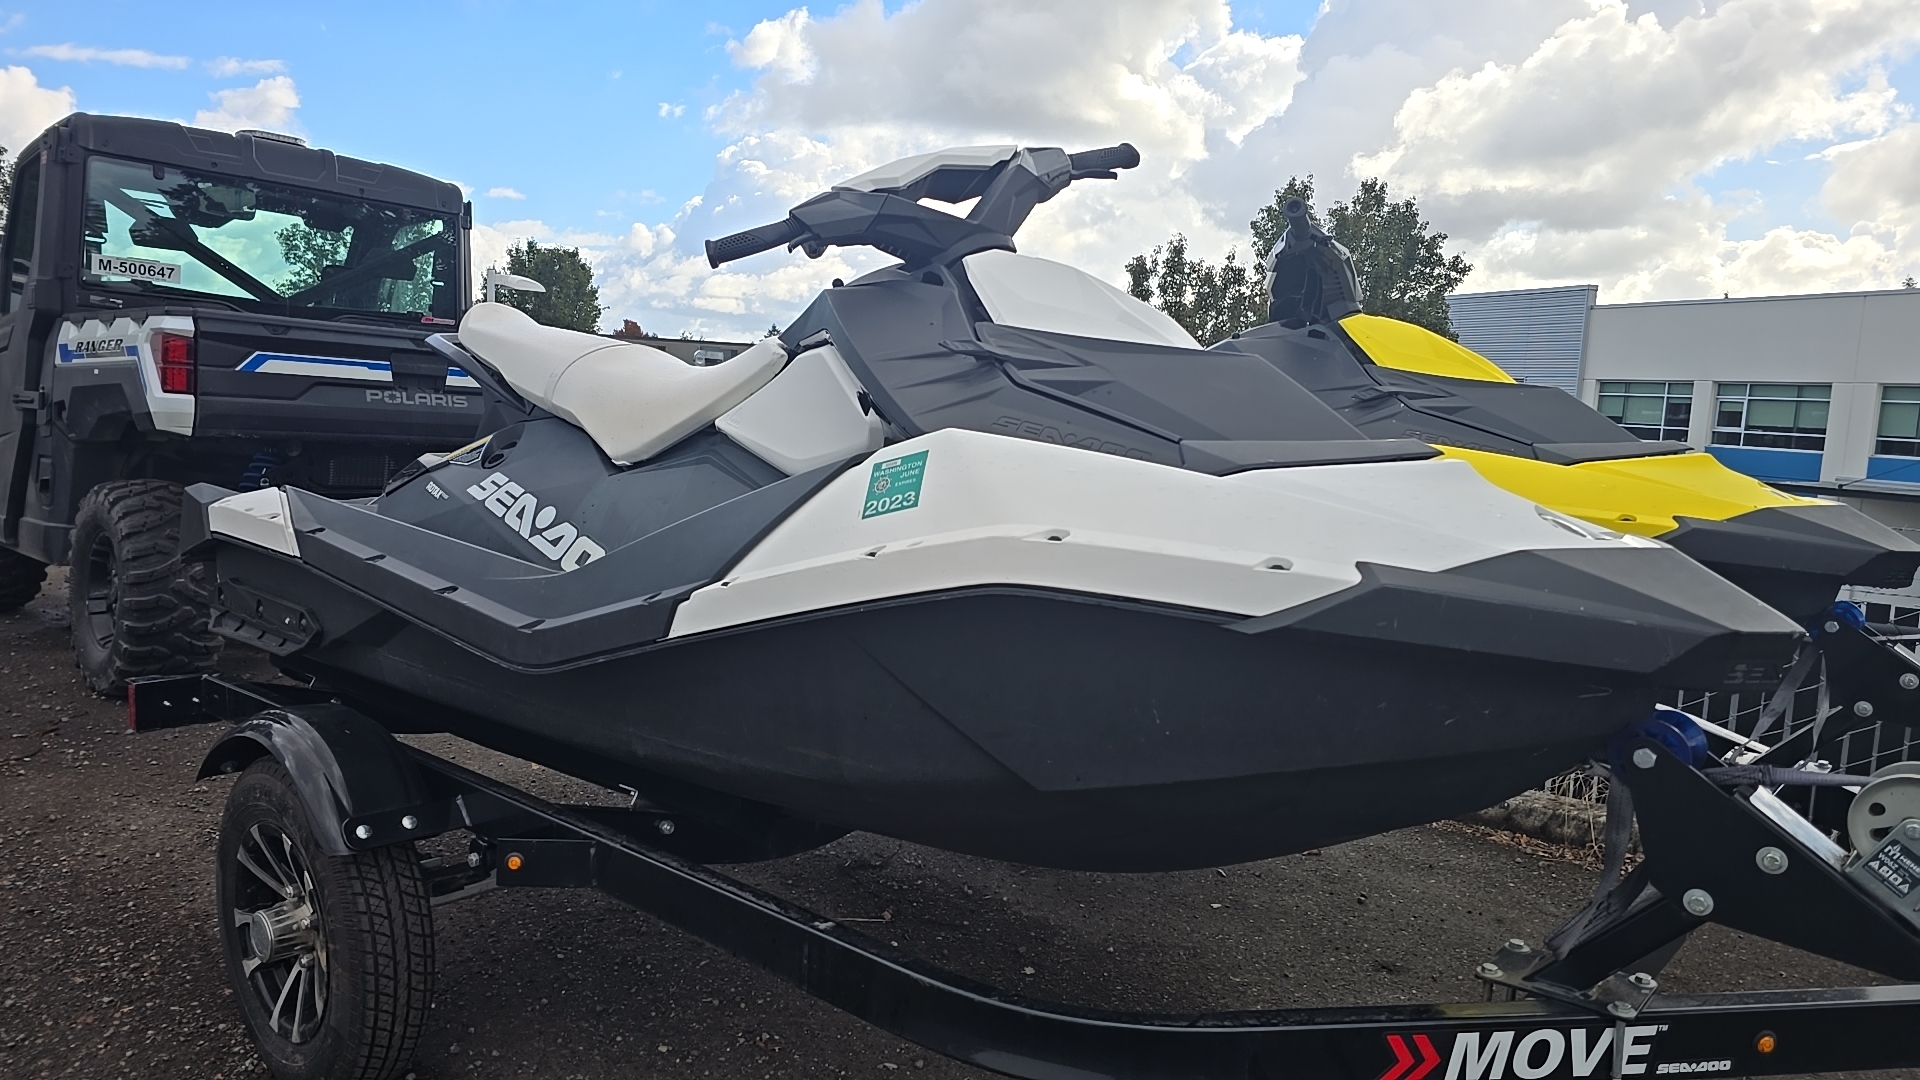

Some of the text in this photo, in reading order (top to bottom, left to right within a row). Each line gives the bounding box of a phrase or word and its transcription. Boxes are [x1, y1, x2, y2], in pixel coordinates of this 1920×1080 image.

[98, 258, 175, 279] M-500647
[75, 338, 124, 353] RANGER
[365, 389, 469, 408] POLARIS
[873, 460, 923, 478] WASHINGTON
[899, 468, 920, 479] JUNE
[863, 491, 916, 516] 2023
[1444, 1025, 1659, 1080] MOVE
